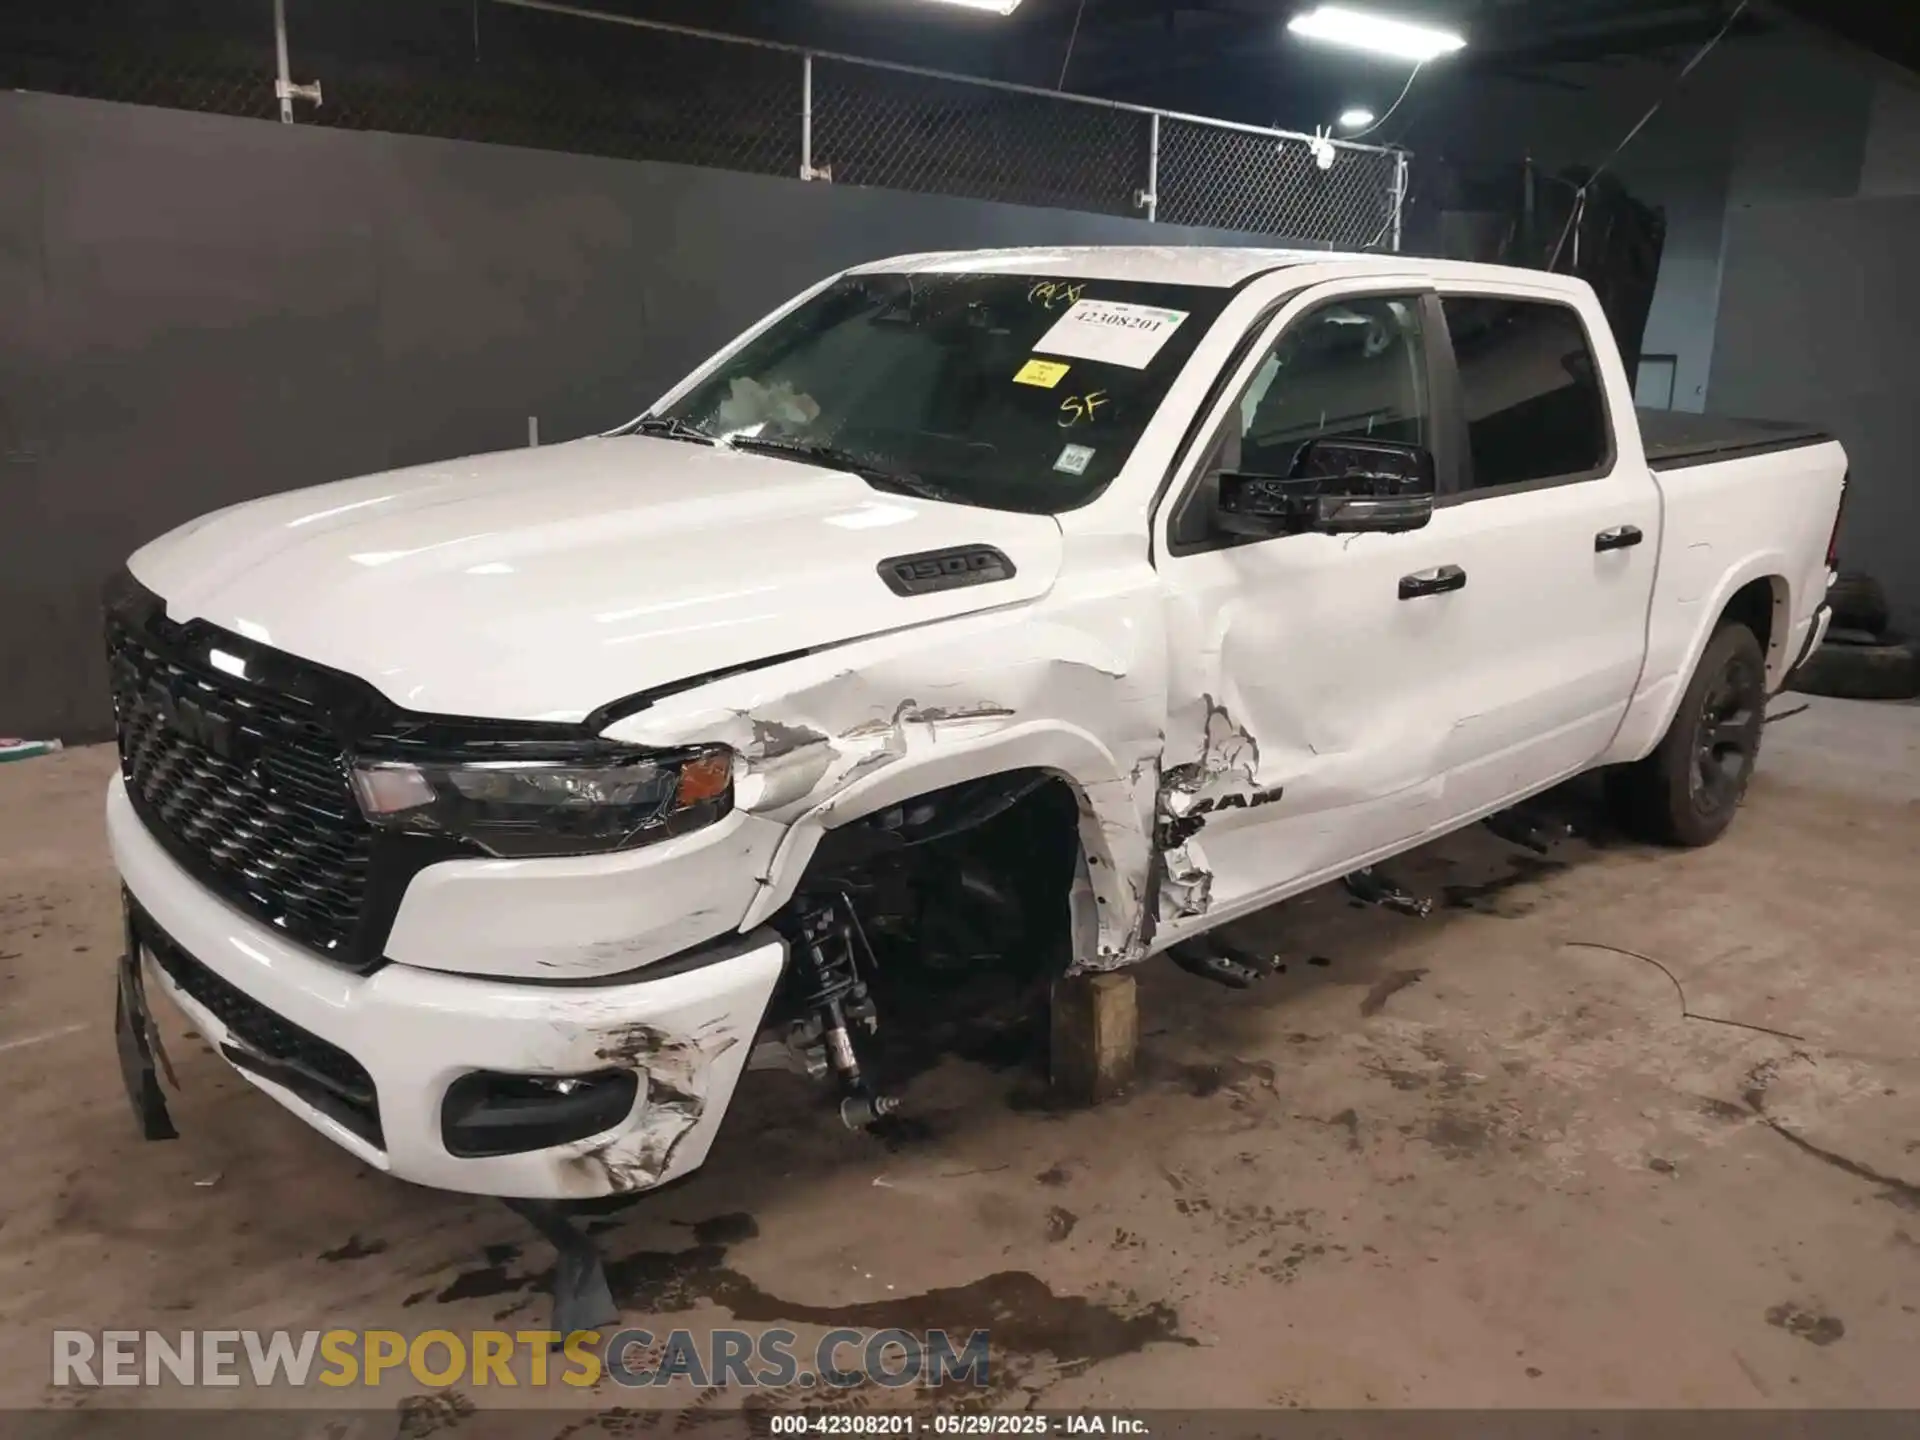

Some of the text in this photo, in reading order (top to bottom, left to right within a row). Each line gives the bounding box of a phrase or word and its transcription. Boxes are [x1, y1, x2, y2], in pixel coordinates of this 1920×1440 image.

[1075, 311, 1162, 332] 42308201
[1057, 389, 1110, 428] SF
[895, 551, 1001, 581] 1500
